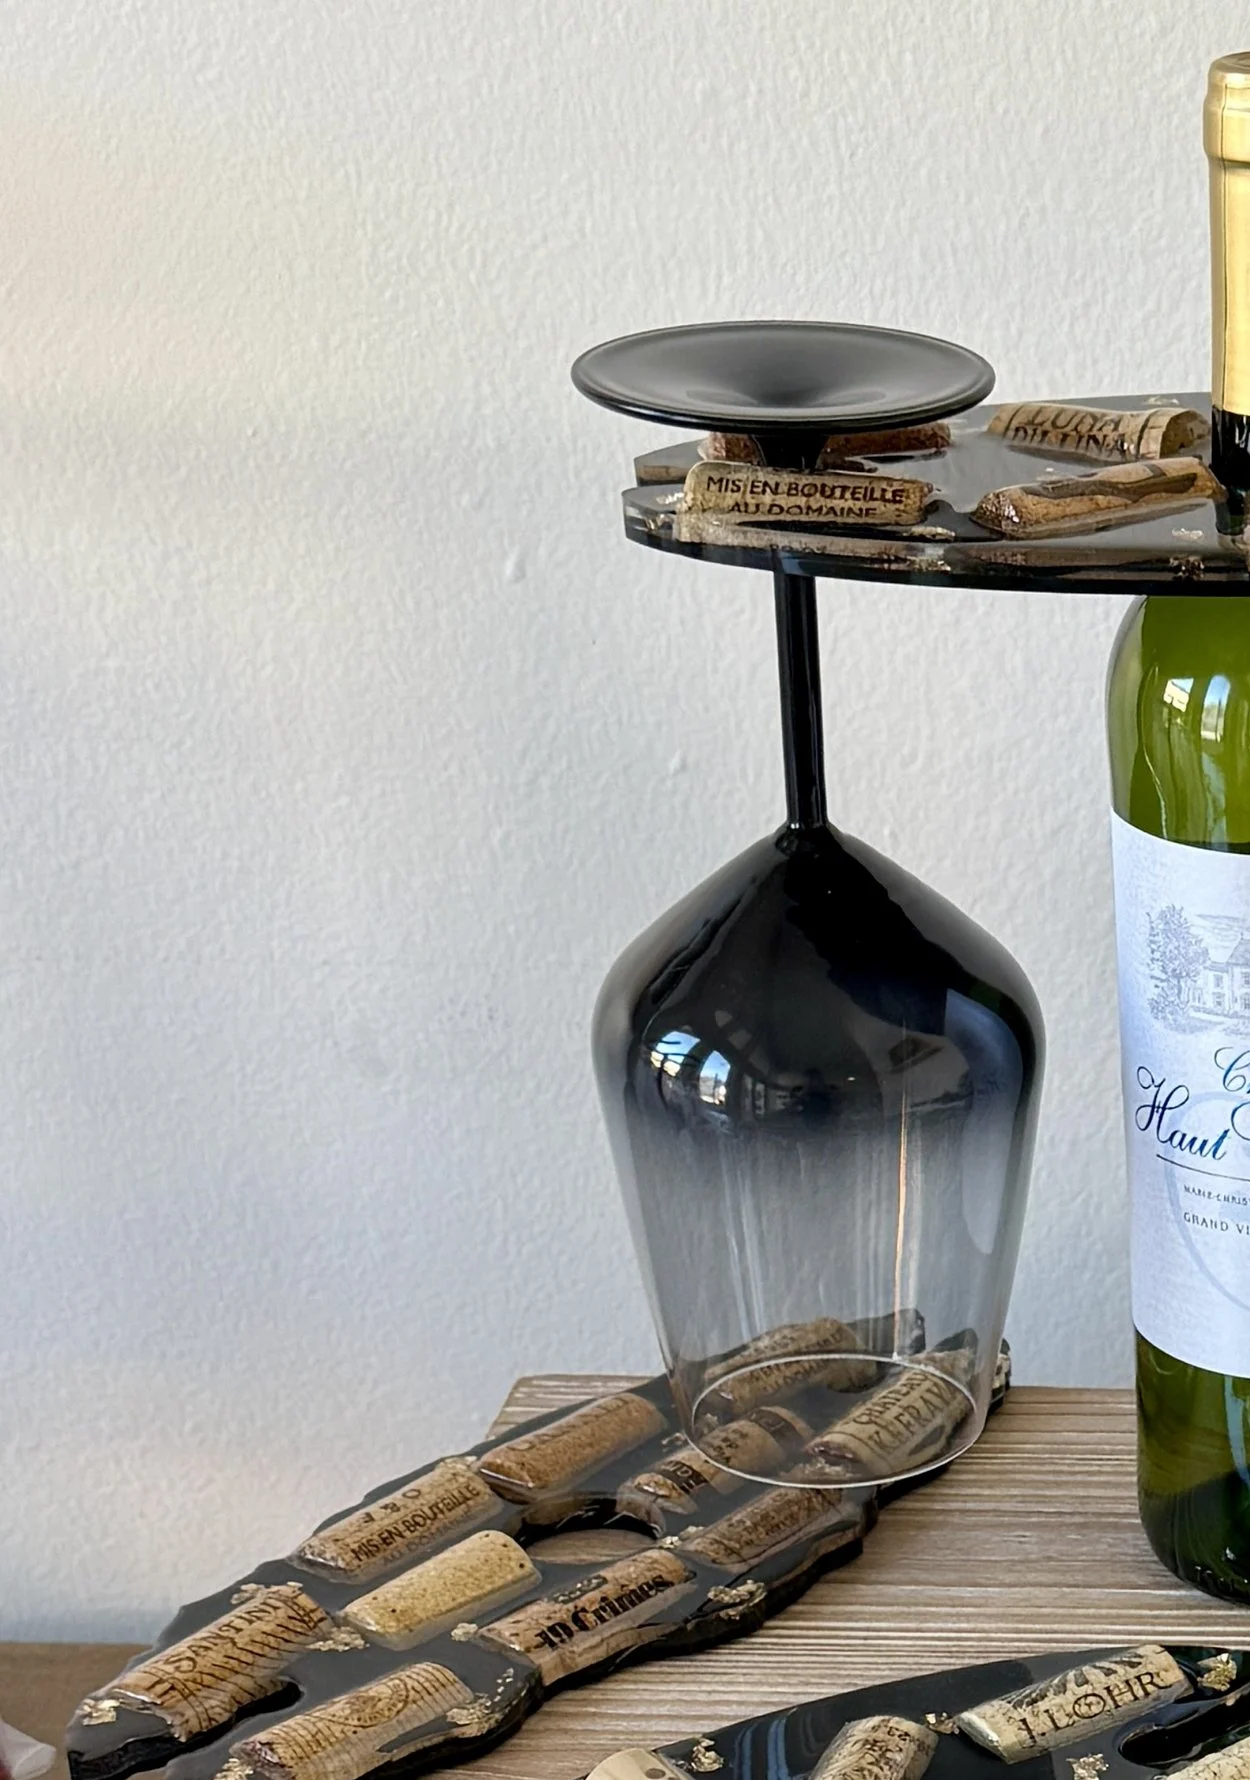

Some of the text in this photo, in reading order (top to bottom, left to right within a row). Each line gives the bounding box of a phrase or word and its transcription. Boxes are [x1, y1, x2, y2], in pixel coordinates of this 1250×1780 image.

[707, 476, 905, 504] MIS EN BOUTEILLE
[729, 502, 877, 518] AU DOMAINE
[1135, 1066, 1229, 1160] Haut
[1184, 1212, 1229, 1232] GRAND
[350, 1539, 380, 1562] MIS
[381, 1526, 404, 1547] EN
[403, 1485, 480, 1534] BOUTEILLE
[571, 1574, 675, 1632] Crimes
[1044, 1671, 1173, 1732] LOHR
